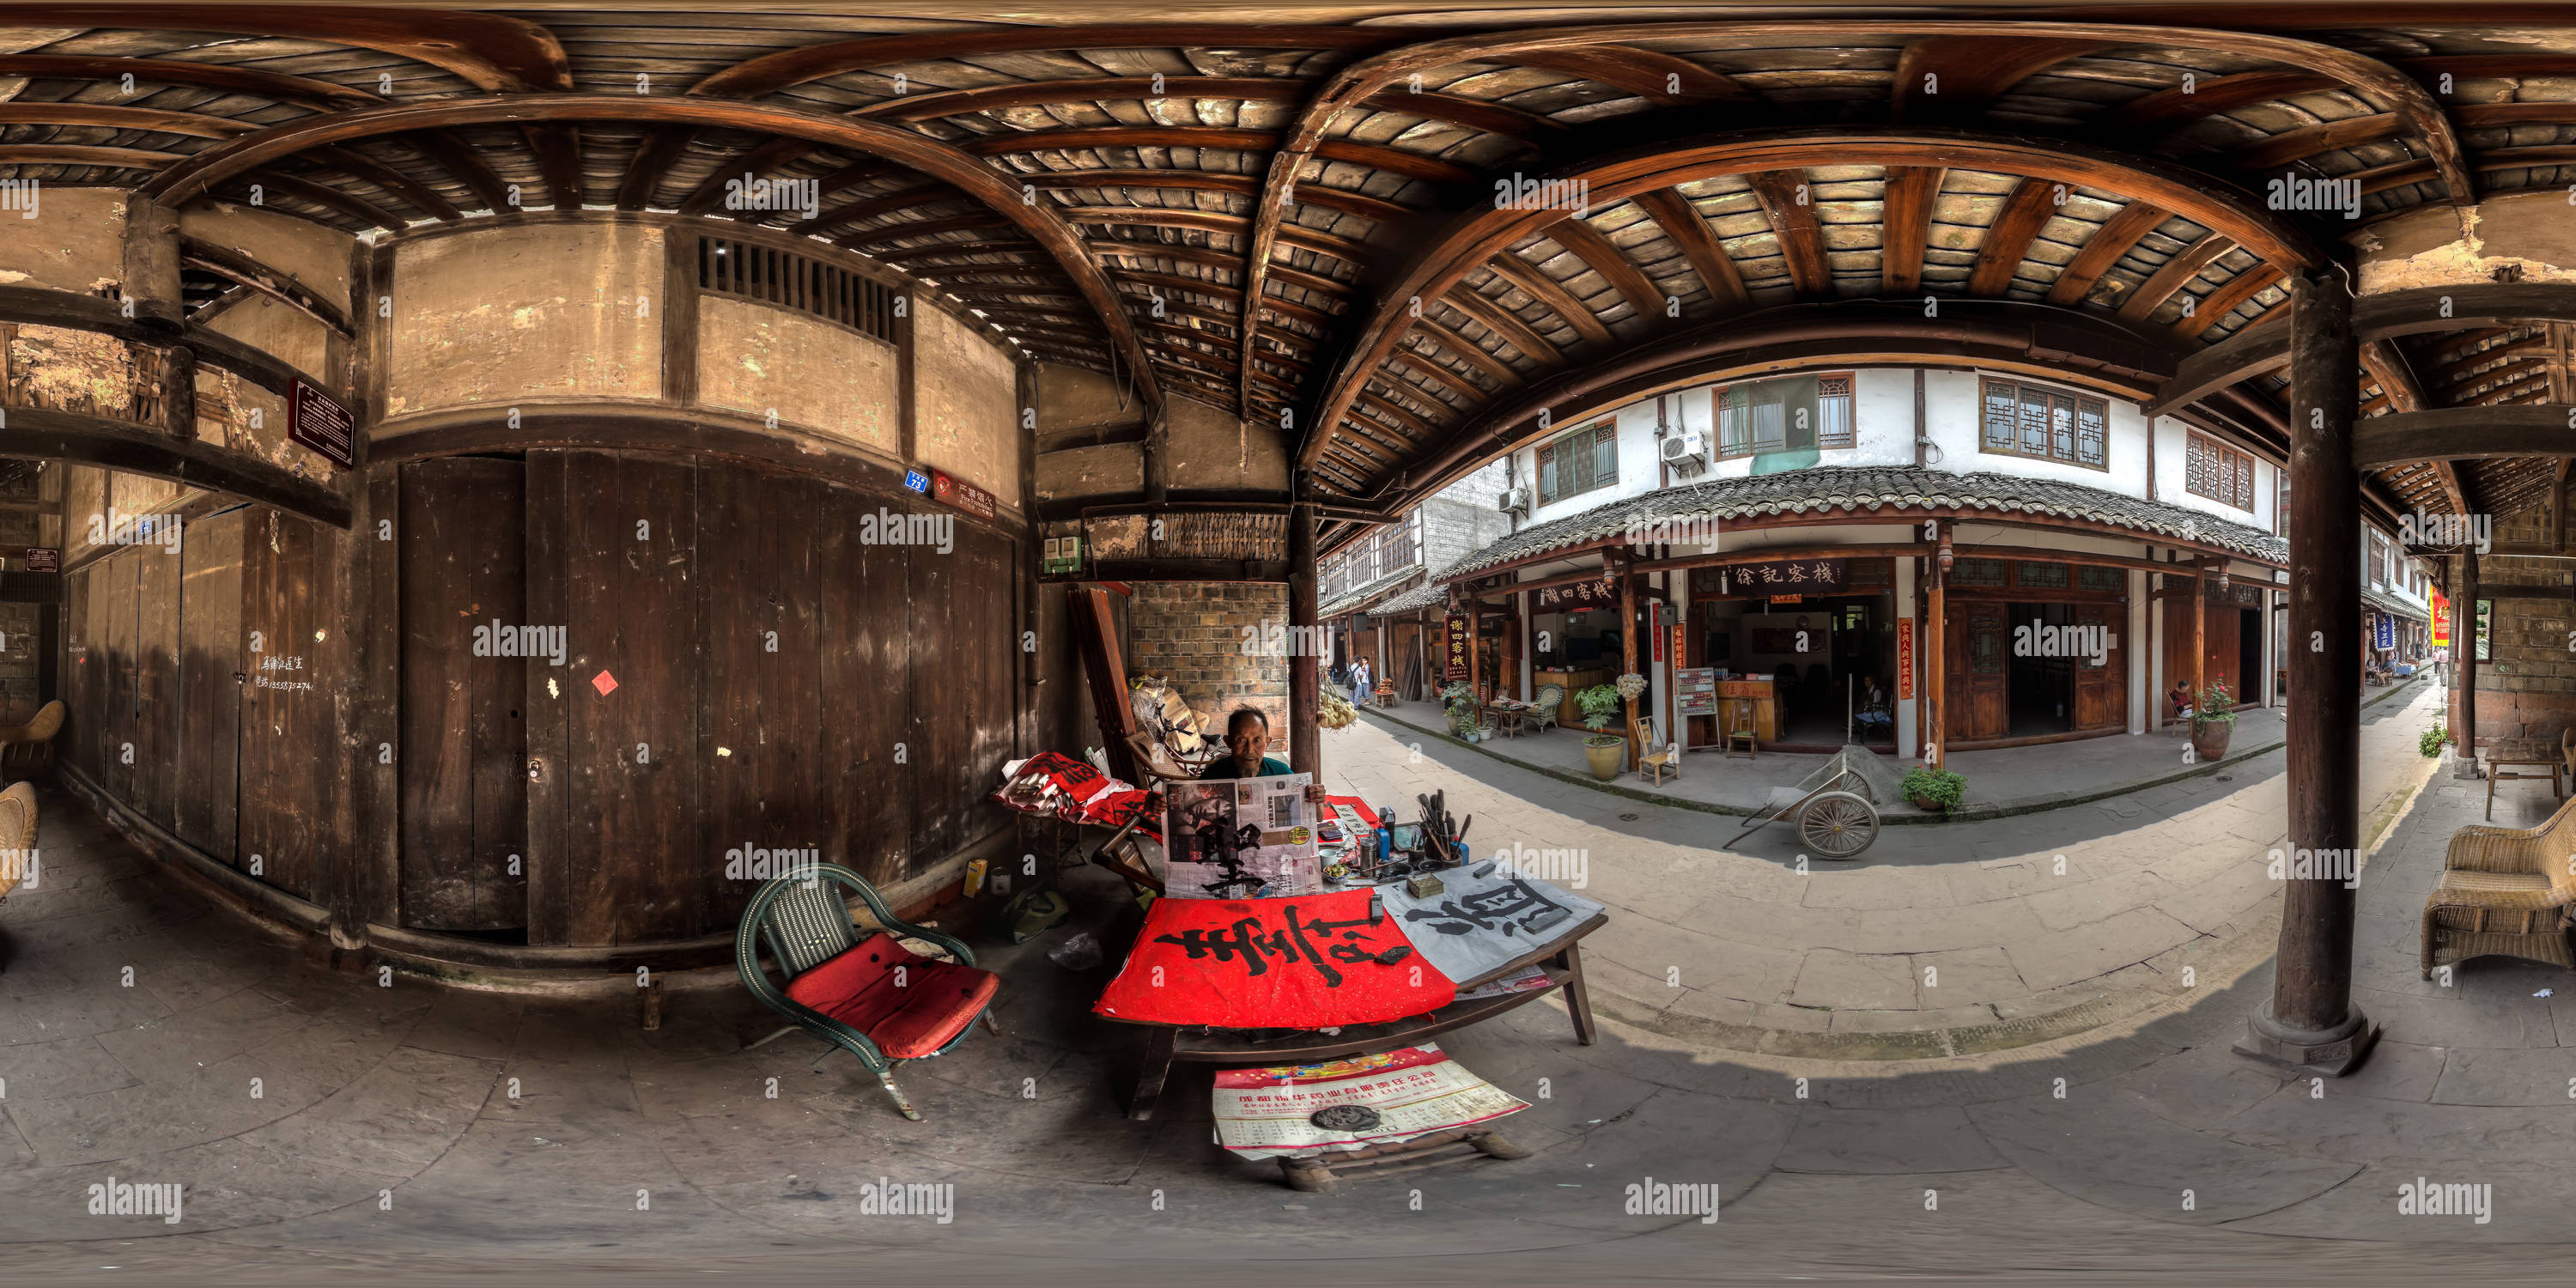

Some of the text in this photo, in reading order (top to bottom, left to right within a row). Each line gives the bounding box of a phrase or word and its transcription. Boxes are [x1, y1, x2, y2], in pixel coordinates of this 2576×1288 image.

[911, 479, 921, 489] 73
[959, 483, 993, 507] 严禁烟火
[1736, 562, 1835, 586] 徐記客棧
[1546, 581, 1612, 604] 谢四客栈
[1450, 619, 1465, 666] 谢四客栈
